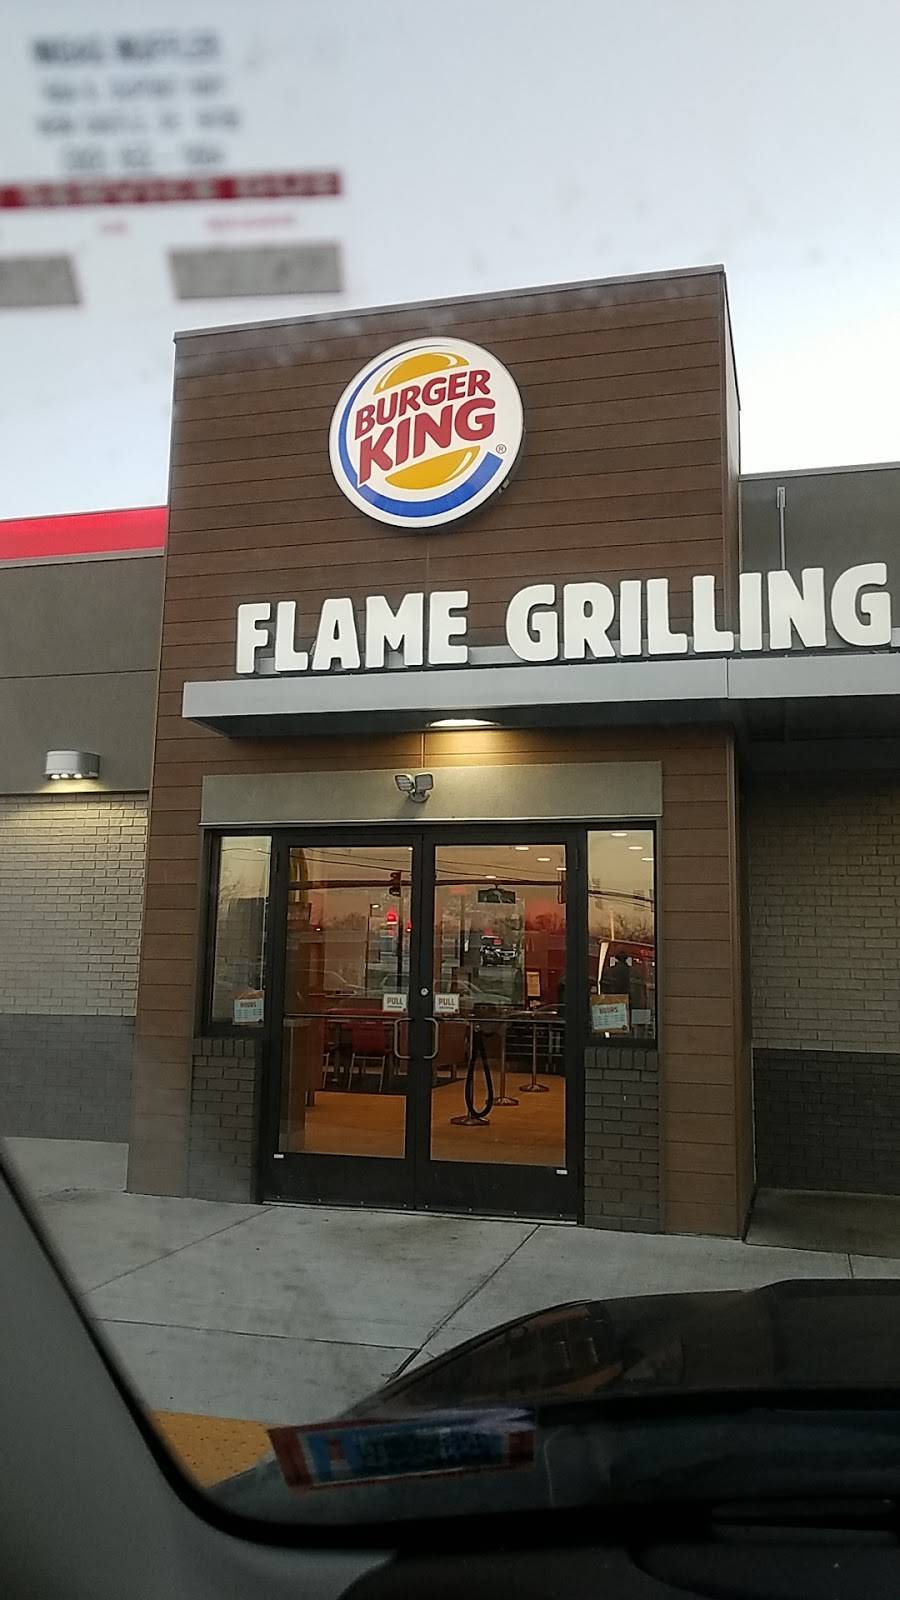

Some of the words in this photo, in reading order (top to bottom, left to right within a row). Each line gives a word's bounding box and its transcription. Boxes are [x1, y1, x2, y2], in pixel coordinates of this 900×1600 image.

[354, 369, 491, 440] BURGER
[359, 397, 496, 484] KING
[235, 590, 469, 675] FLAME
[506, 562, 892, 664] GRILLING
[387, 996, 403, 1005] PULL
[438, 997, 455, 1006] PULL
